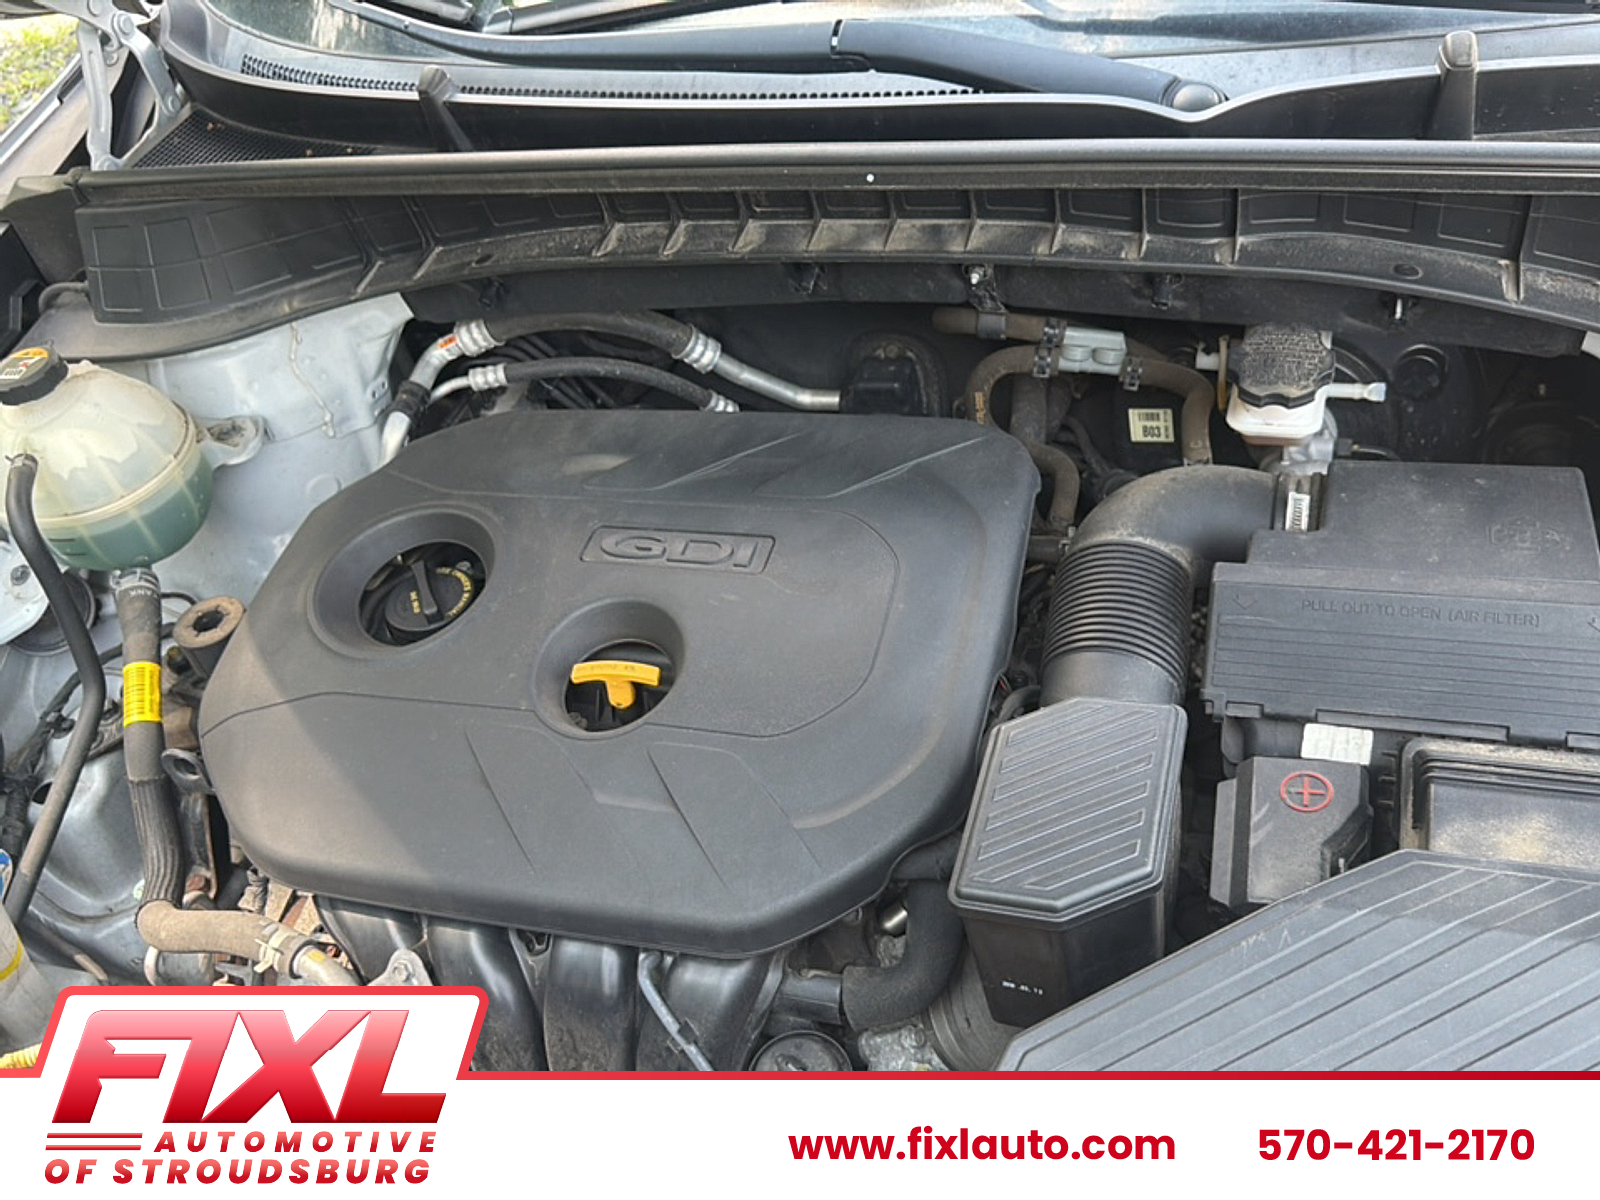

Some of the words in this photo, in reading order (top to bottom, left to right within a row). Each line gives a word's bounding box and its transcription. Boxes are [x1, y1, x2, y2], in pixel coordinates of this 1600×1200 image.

[600, 535, 760, 568] GDI
[1301, 600, 1338, 613] PULL
[1342, 601, 1372, 615] OUT
[1376, 603, 1396, 617] TO
[1400, 605, 1442, 621] OPEN
